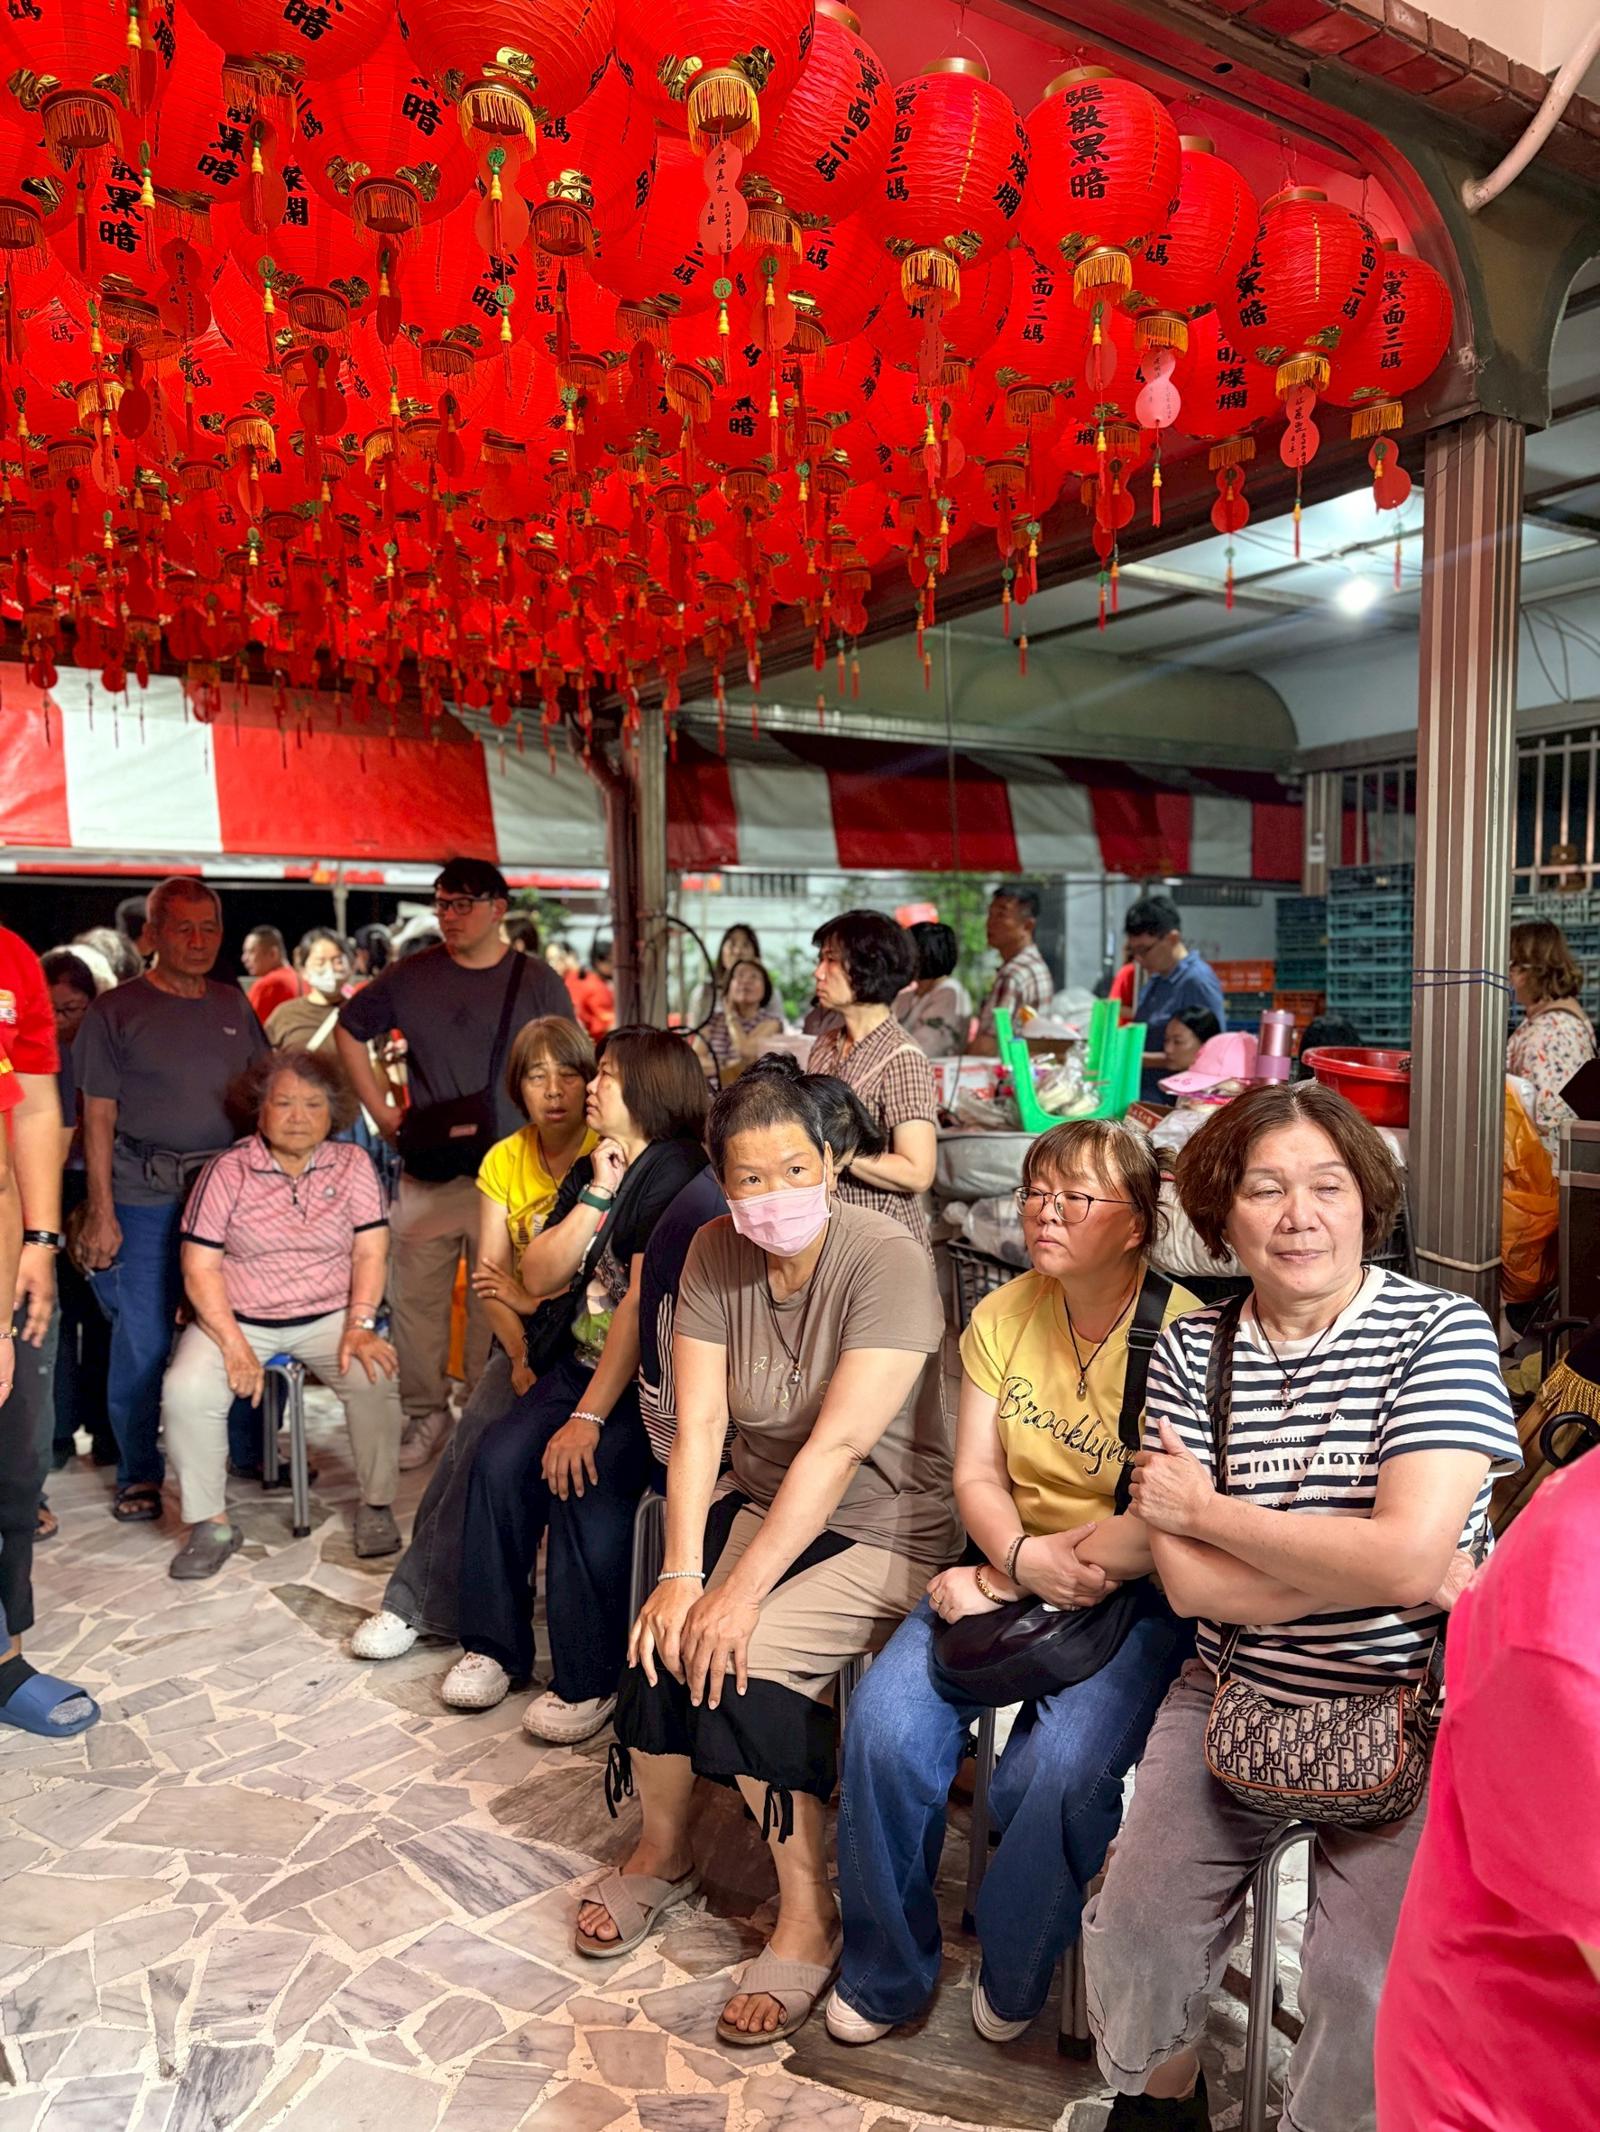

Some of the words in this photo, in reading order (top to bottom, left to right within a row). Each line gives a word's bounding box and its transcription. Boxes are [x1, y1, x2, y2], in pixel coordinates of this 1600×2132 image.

[815, 64, 882, 182] 黑面三媽
[885, 92, 919, 201] 黑面三媽
[671, 241, 704, 285] 三媽
[1381, 281, 1407, 369] 黑面三媽
[1216, 328, 1248, 412] 明燦爛
[1000, 1376, 1133, 1475] Brooklyn
[1309, 1446, 1369, 1486] day
